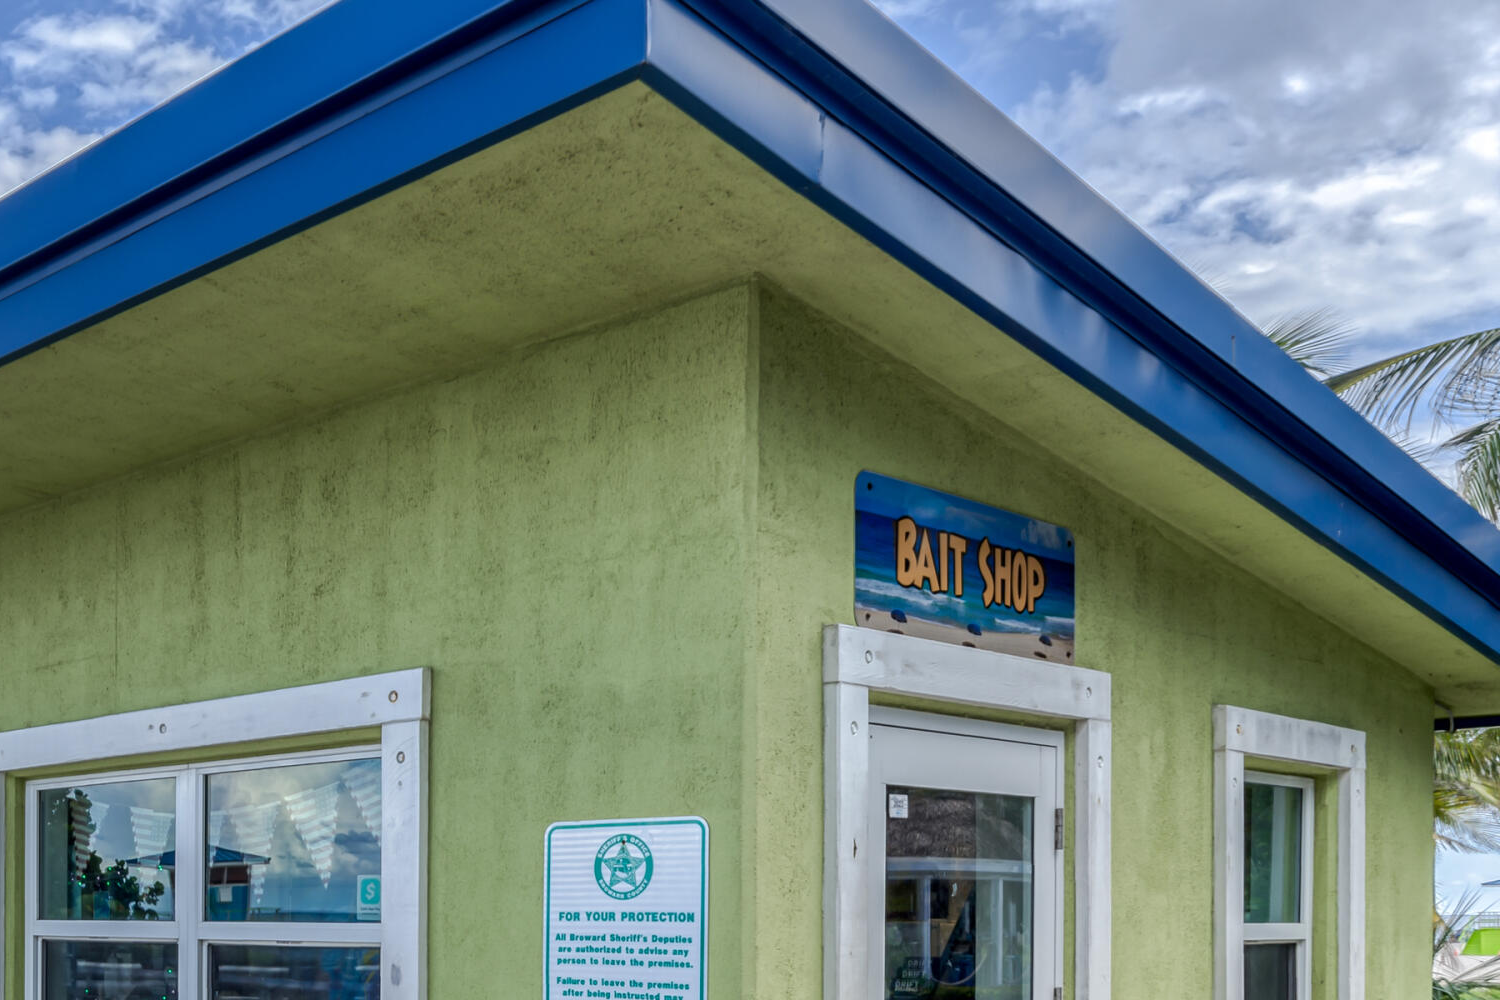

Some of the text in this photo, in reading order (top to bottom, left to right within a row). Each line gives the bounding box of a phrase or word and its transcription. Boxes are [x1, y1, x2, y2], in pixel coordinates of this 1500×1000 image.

[896, 516, 1047, 615] BAIT SHOP
[558, 912, 695, 922] FOR YOUR PROTECTION
[556, 933, 692, 944] All Broward Sheriff's Deputies
[576, 945, 622, 954] authorized
[626, 946, 634, 954] to
[638, 946, 668, 955] advise
[672, 948, 689, 958] any
[590, 957, 598, 965] to
[602, 958, 626, 966] leave
[630, 958, 644, 966] the
[648, 960, 694, 968] premises.
[556, 976, 690, 990] Failure to leave the premises
[562, 988, 584, 996] after
[587, 990, 611, 1000] being
[614, 991, 660, 1000] instructed
